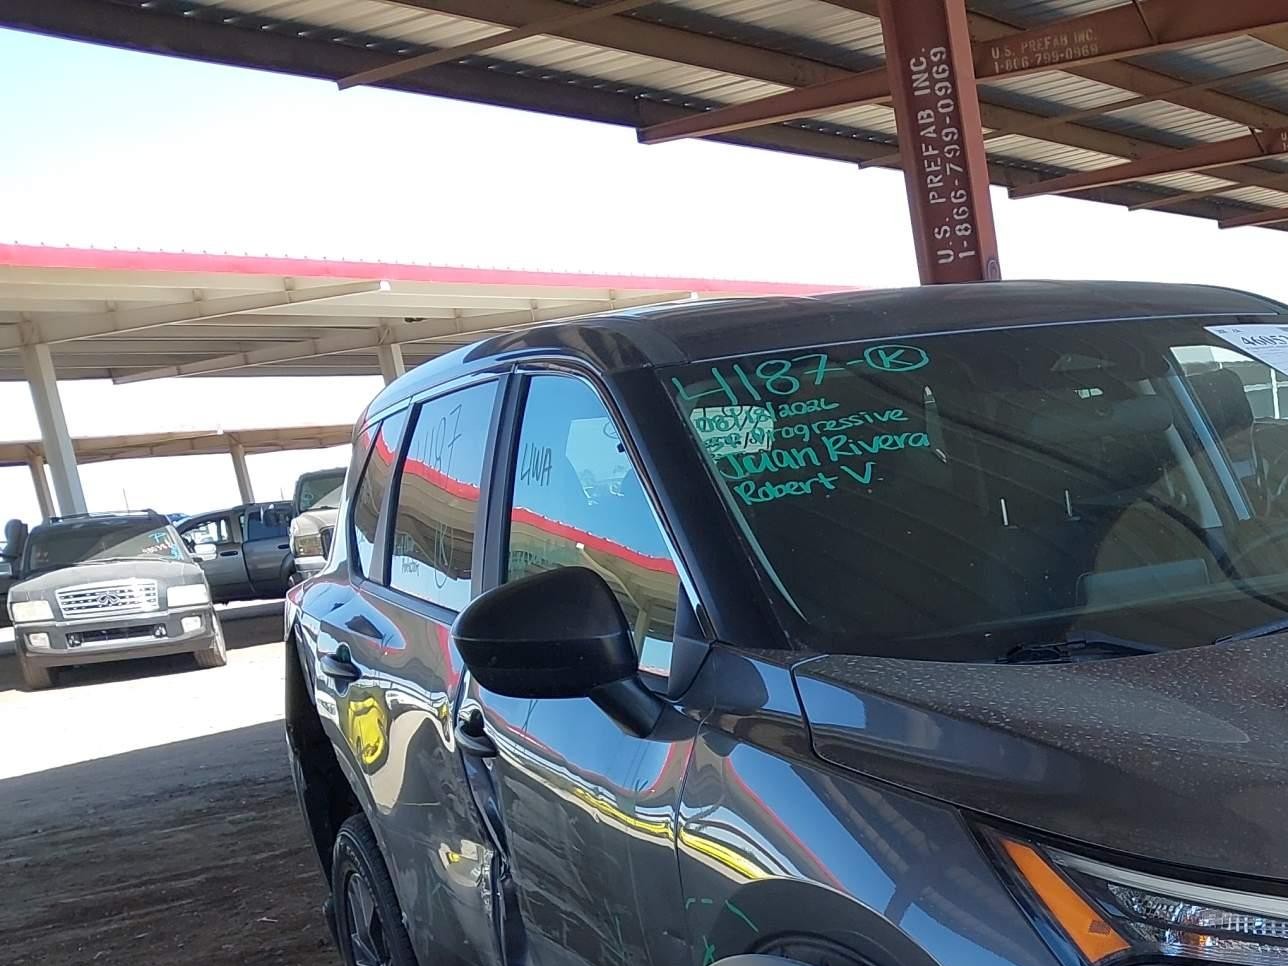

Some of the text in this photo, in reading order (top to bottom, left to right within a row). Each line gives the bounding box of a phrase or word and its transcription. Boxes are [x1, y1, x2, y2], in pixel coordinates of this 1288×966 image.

[1021, 35, 1069, 53] PREFAB
[909, 47, 955, 264] U.S. PREFAB INC.
[929, 46, 976, 259] 1-866-799-0969
[821, 432, 931, 463] Rivera
[733, 461, 877, 506] Robert V
